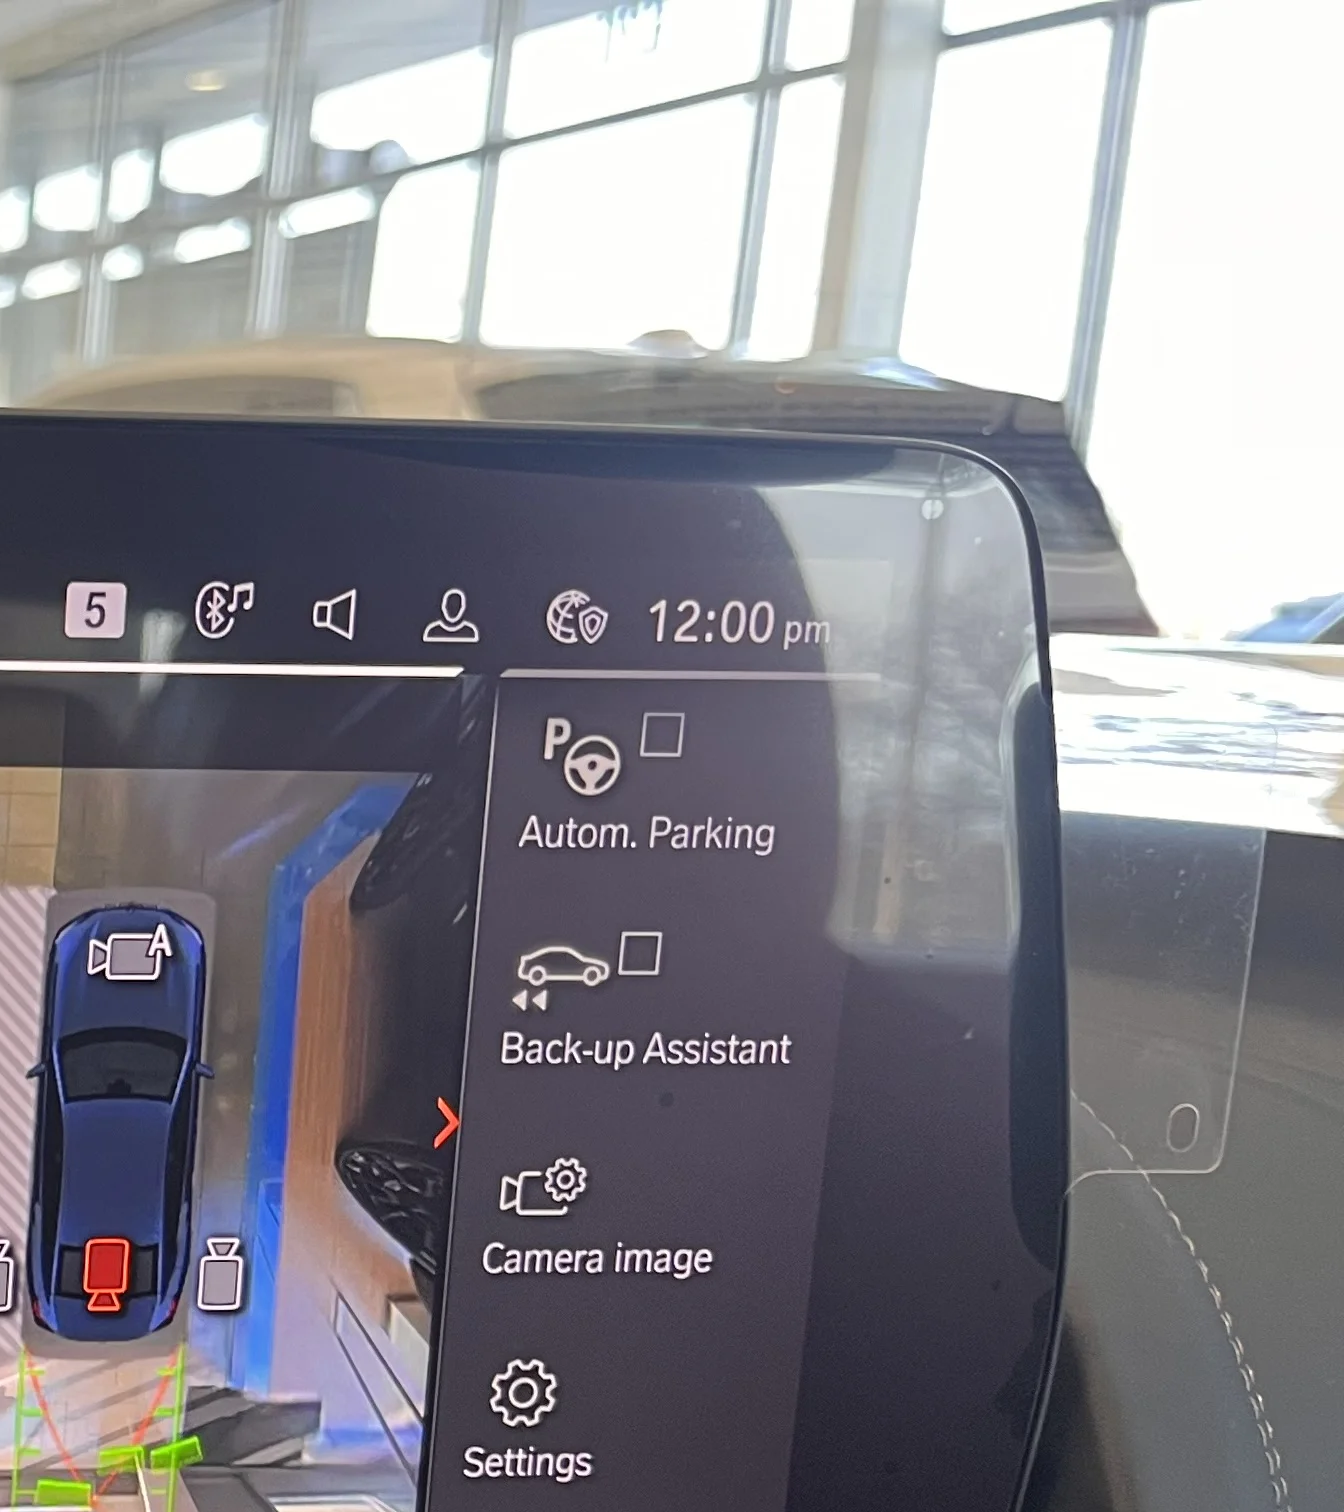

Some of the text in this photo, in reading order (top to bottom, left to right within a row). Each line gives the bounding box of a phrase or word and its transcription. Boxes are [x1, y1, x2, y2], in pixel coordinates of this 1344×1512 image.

[84, 592, 107, 630] 5
[648, 599, 832, 651] 12:00 pm
[544, 717, 572, 760] P
[518, 815, 776, 856] Autom. Parking
[146, 924, 173, 957] A
[500, 1031, 793, 1071] Back-up Assistant
[481, 1242, 713, 1279] Camera image
[462, 1446, 594, 1483] Settings
